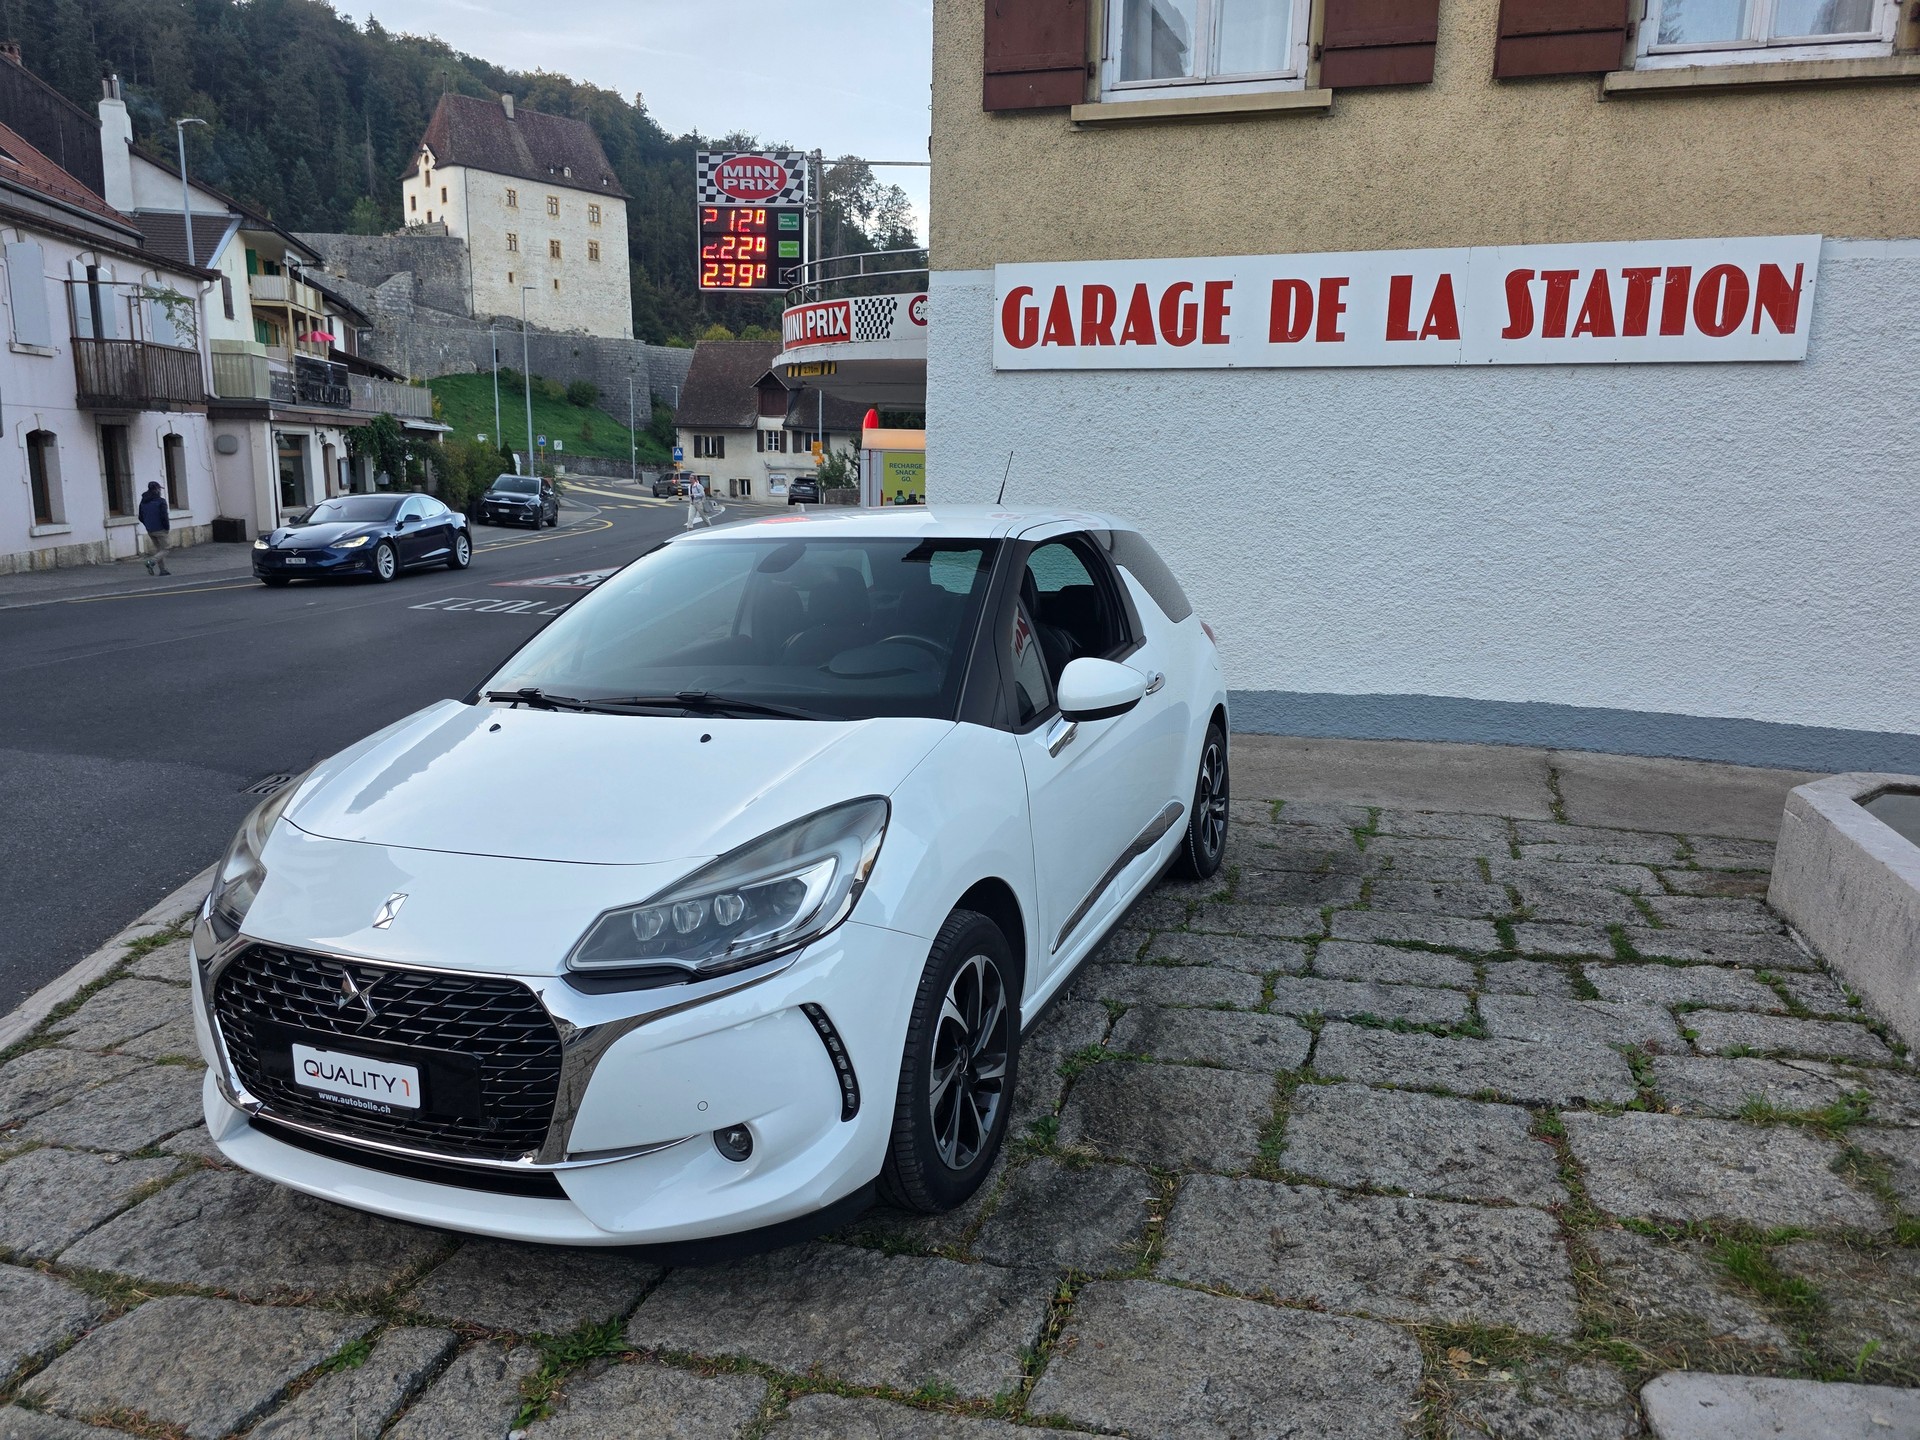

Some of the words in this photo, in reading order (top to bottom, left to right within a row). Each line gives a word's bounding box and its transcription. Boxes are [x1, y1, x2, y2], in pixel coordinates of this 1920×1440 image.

[722, 165, 779, 178] MINI
[722, 178, 780, 190] PRIX
[1001, 281, 1234, 350] GARAGE
[1269, 277, 1350, 344] DE
[1386, 273, 1460, 341] LA
[1501, 263, 1804, 339] STATION
[806, 305, 848, 339] PRIX
[304, 1059, 397, 1093] QUALITY
[401, 1079, 410, 1097] 1
[318, 1091, 391, 1114] www.autobolle.ch
